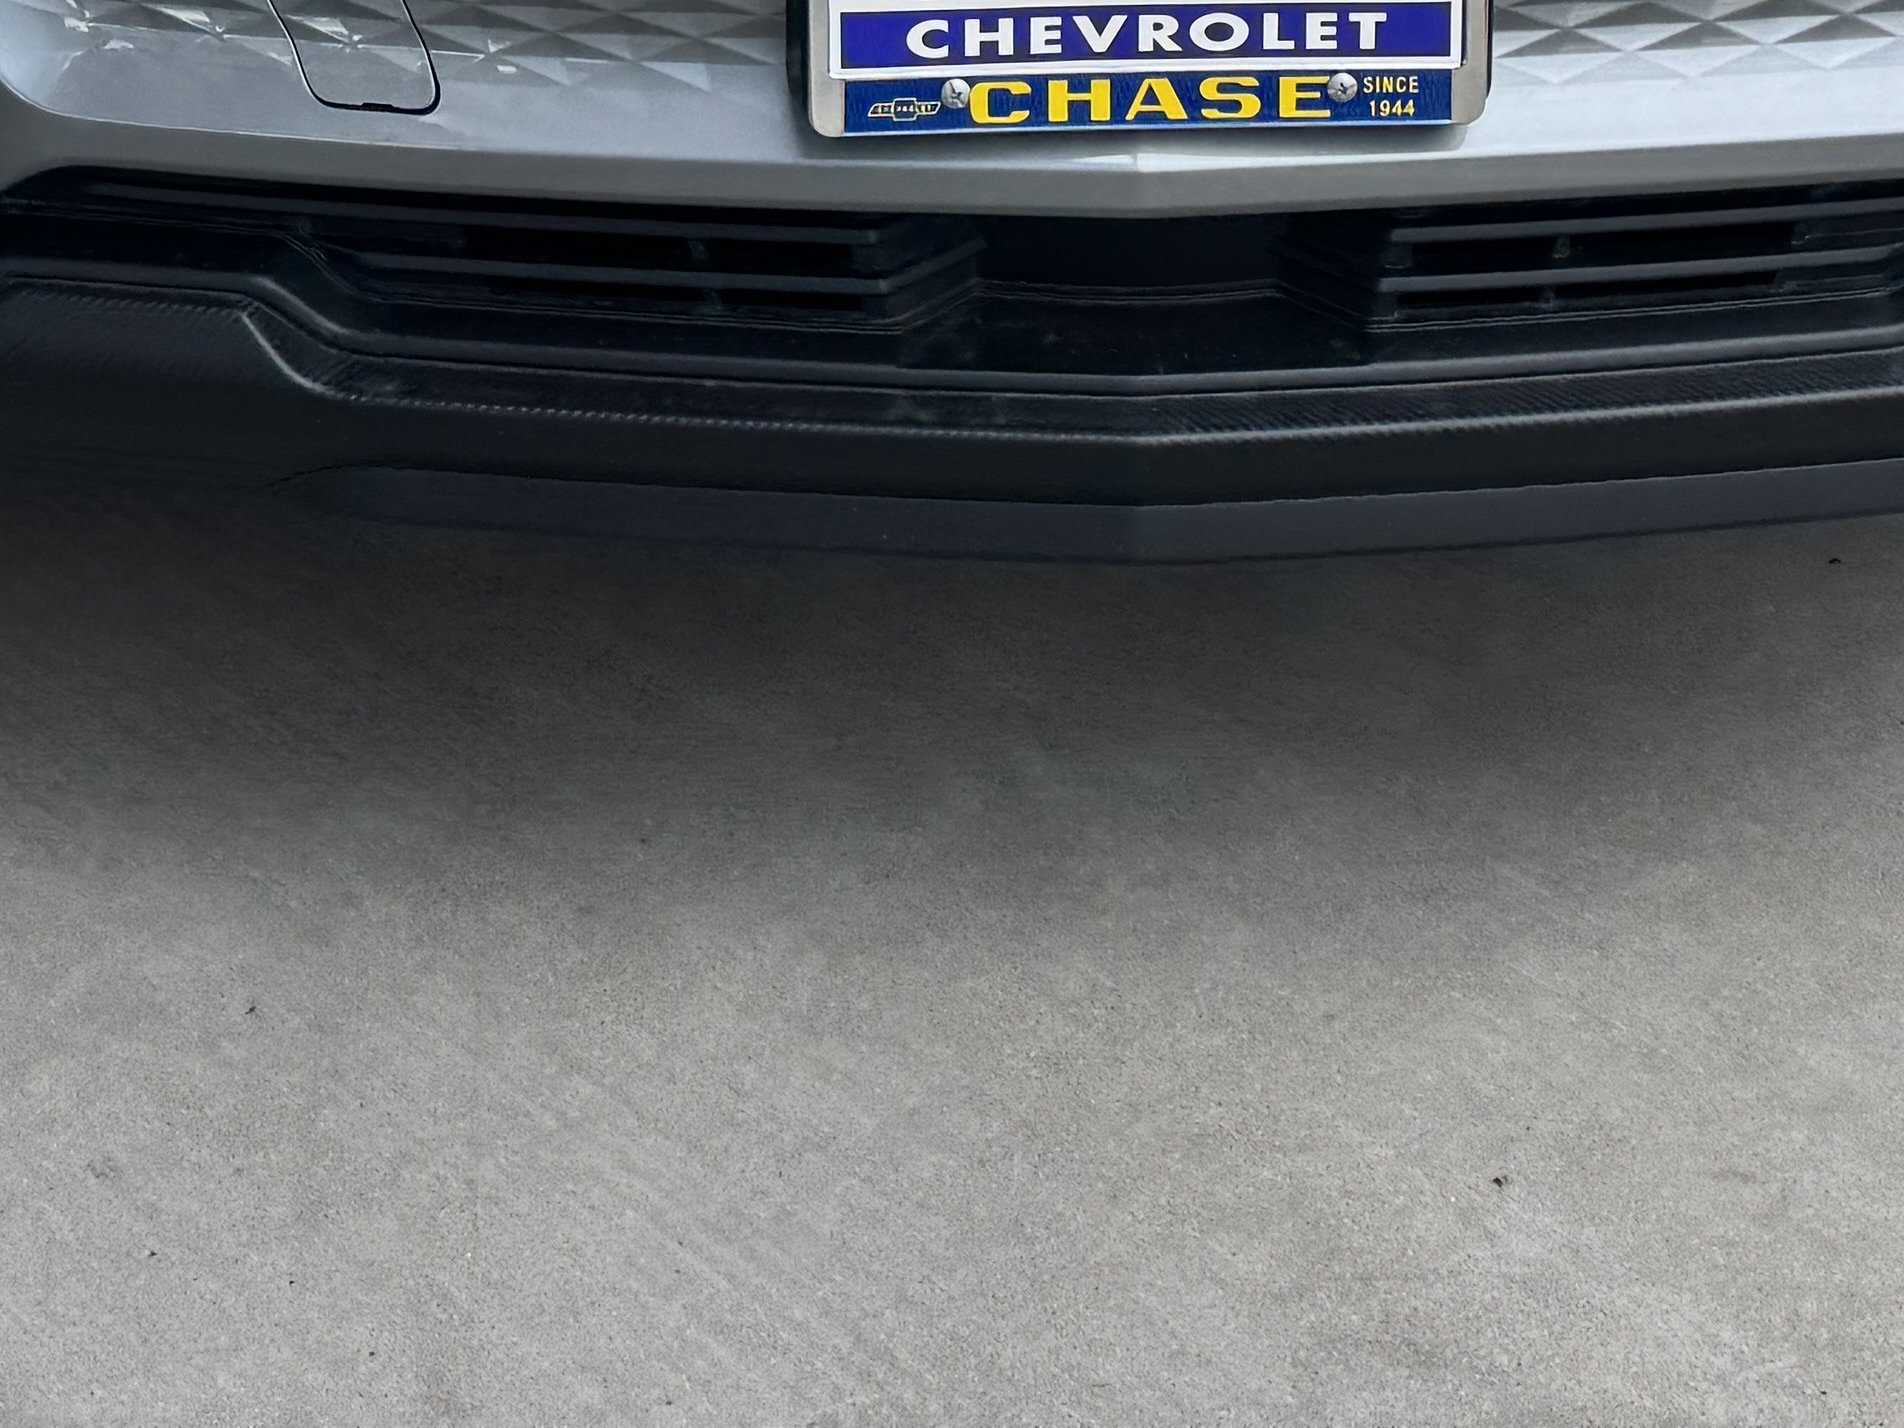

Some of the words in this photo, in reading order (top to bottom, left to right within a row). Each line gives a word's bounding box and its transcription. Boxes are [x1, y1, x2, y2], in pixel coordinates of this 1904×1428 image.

[905, 11, 1389, 60] CHEVROLET
[968, 75, 1332, 124] CHASE
[1362, 75, 1420, 94] SINCE
[1368, 99, 1416, 117] 1944
